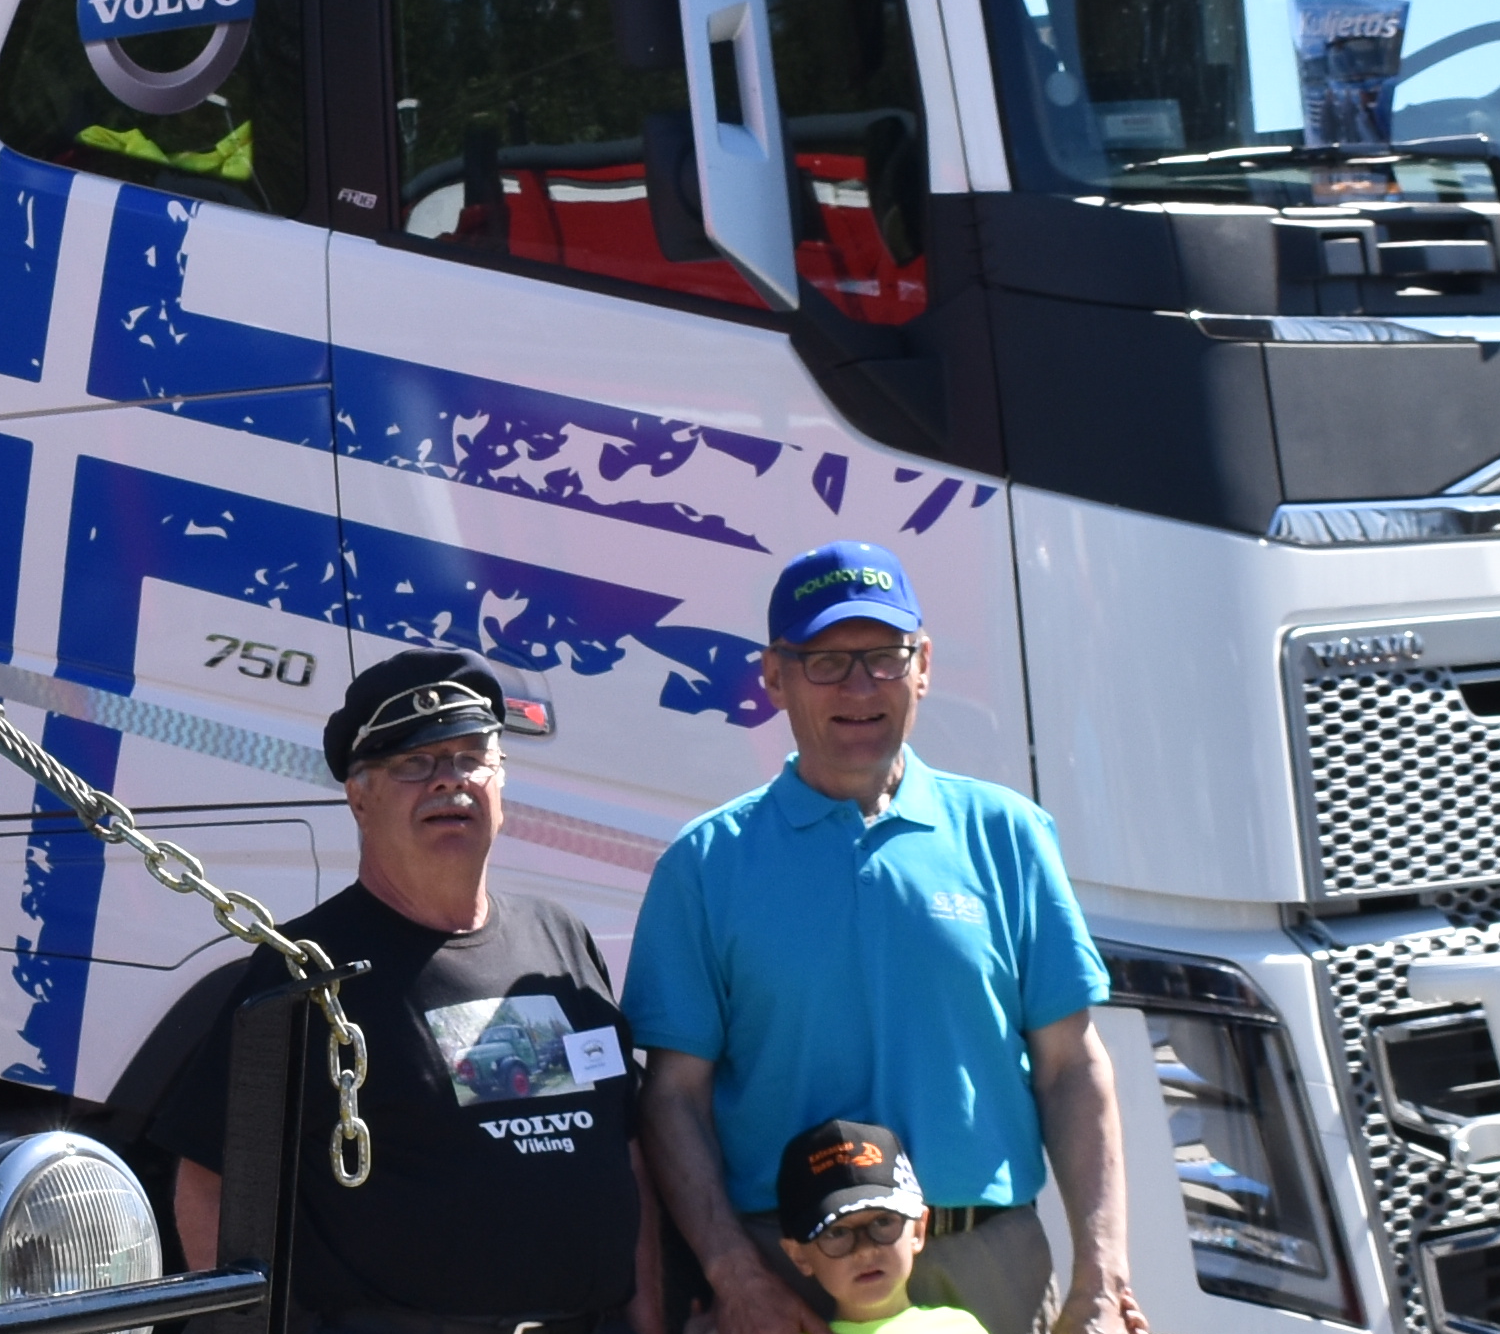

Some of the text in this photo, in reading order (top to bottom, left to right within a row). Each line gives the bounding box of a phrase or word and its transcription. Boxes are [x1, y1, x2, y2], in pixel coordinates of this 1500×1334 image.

[862, 566, 893, 592] 50
[204, 634, 317, 687] 750
[479, 1111, 594, 1139] VOLVO
[513, 1137, 575, 1154] Viking
